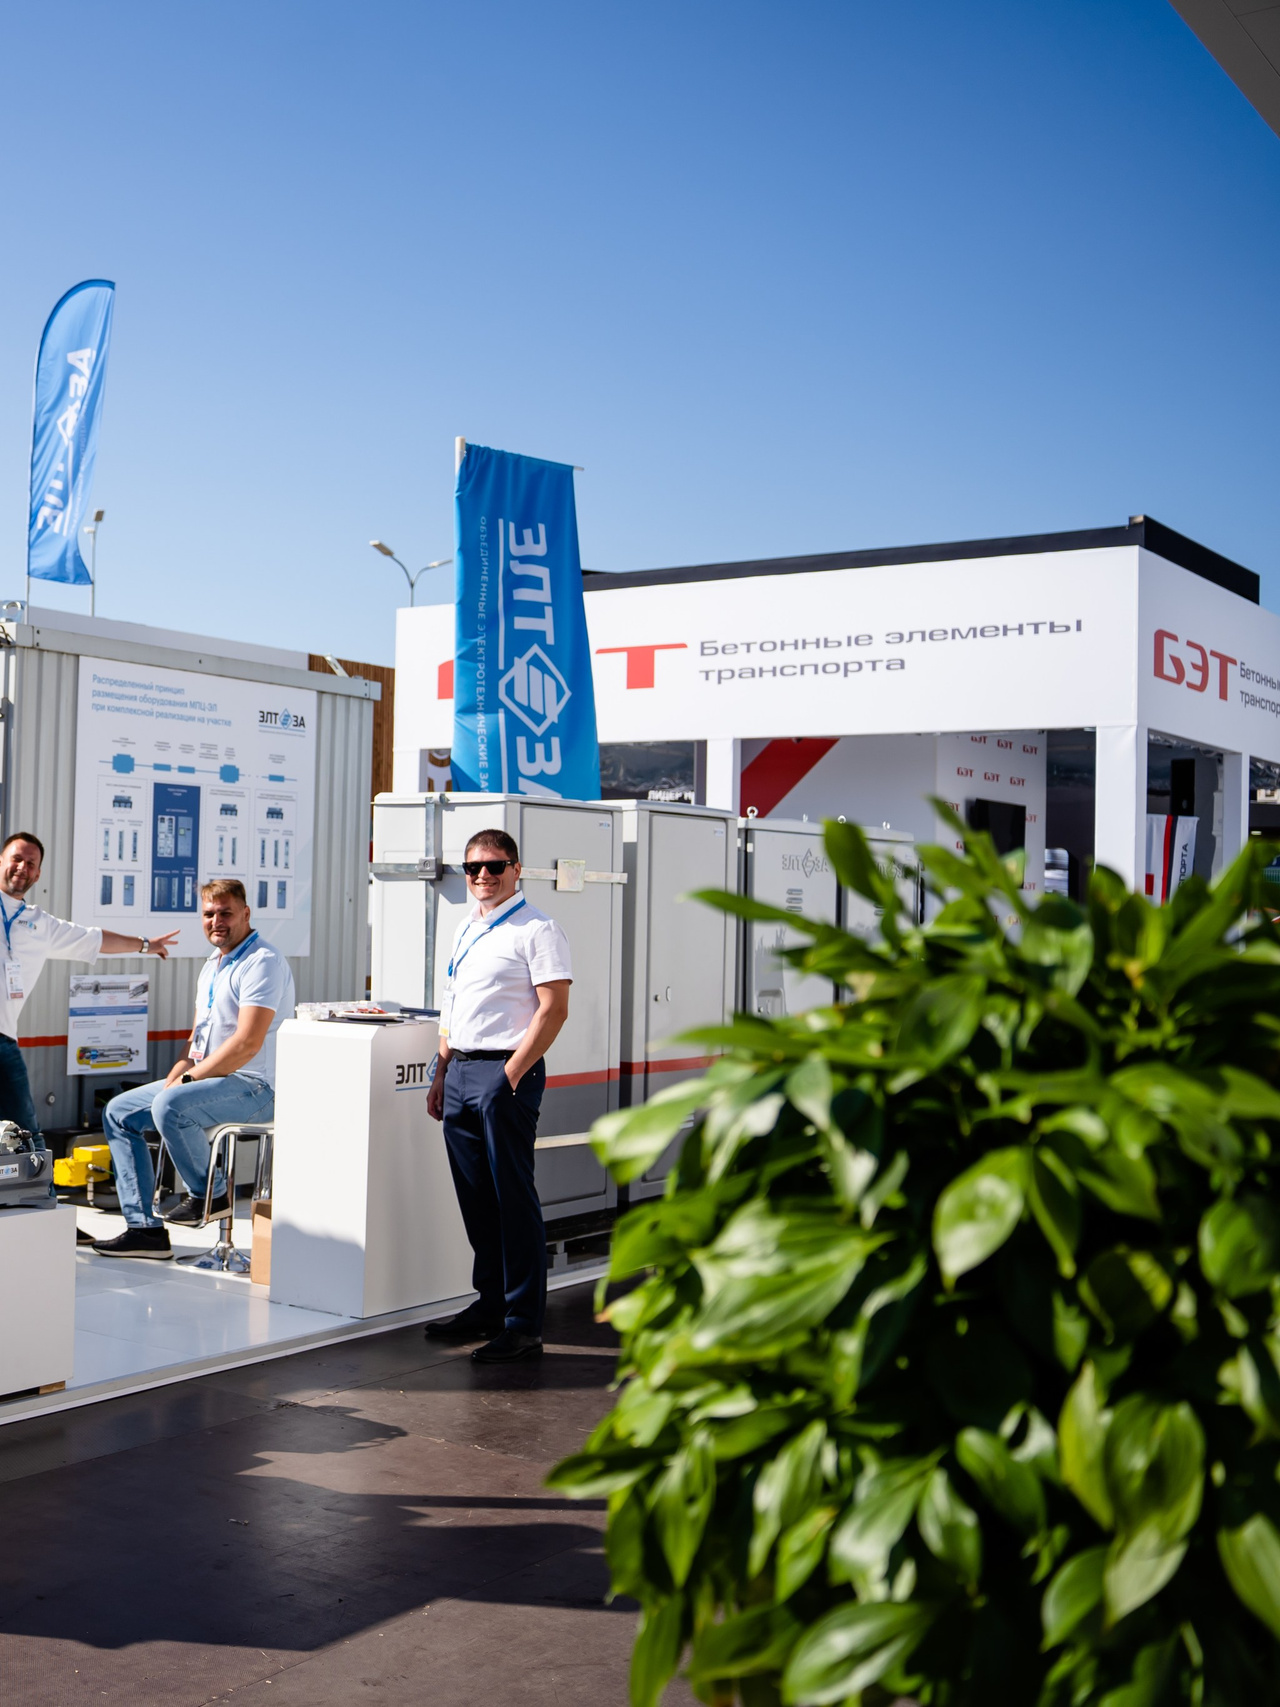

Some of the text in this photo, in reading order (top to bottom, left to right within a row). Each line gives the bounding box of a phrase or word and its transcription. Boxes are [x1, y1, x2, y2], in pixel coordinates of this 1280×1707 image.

[700, 619, 1082, 656] Бетонные элементы
[699, 658, 906, 684] транспорта
[1153, 628, 1238, 701] БЭТ
[92, 673, 185, 695] Распределенный принцип
[92, 689, 137, 701] размещения
[139, 693, 188, 708] оборудования
[92, 703, 105, 712] при
[107, 704, 154, 717] комплексной
[156, 711, 196, 723] реализации
